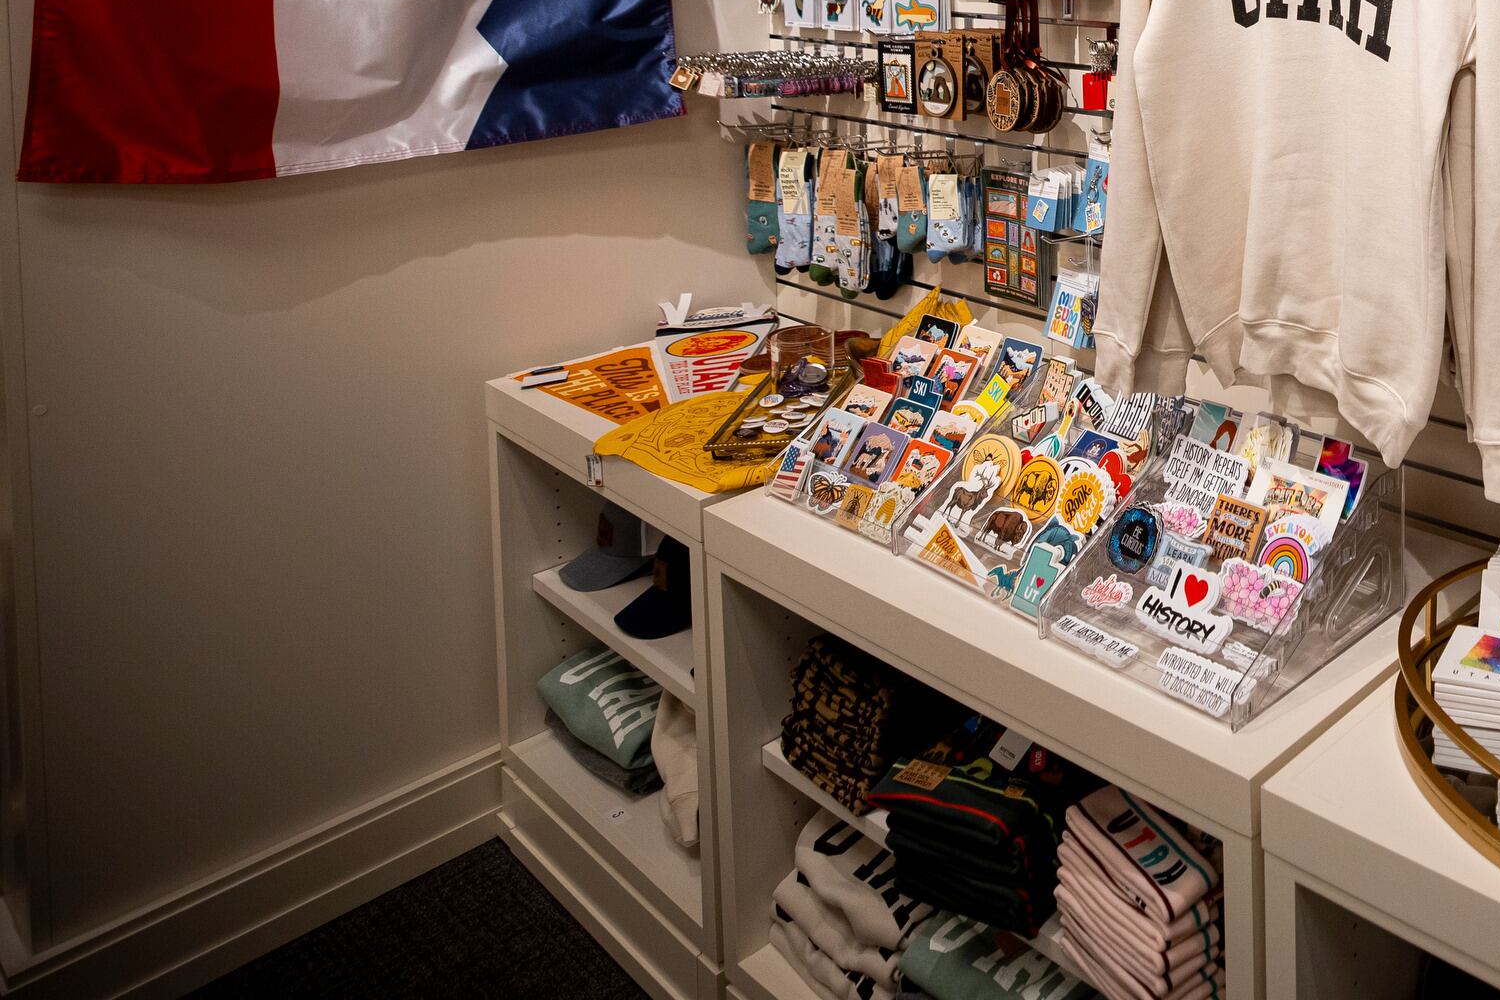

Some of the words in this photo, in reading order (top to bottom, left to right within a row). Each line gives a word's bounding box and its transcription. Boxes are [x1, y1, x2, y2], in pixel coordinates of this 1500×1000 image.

[991, 173, 1018, 183] EXPLORE
[1058, 291, 1082, 312] MUS
[1051, 319, 1075, 339] NERD
[543, 368, 608, 396] THE
[594, 357, 655, 390] This
[625, 384, 661, 402] IS
[691, 352, 749, 393] UTAH
[913, 380, 928, 397] SKI
[988, 381, 1004, 403] SKI
[570, 389, 641, 419] PLACE
[1173, 438, 1183, 456] IF
[1182, 441, 1213, 468] HISTORY
[1211, 453, 1243, 481] REPEATS
[1166, 457, 1191, 480] ITSELF
[1189, 466, 1205, 486] I'M
[1203, 473, 1237, 496] GETTING
[1168, 480, 1178, 497] A
[1176, 482, 1216, 514] DINOSAUR
[1219, 499, 1261, 522] THERE'S
[1121, 533, 1145, 556] CURIOUS
[1133, 525, 1143, 540] BE
[1211, 518, 1255, 544] MORE
[1266, 522, 1317, 552] EVERYONE
[1166, 547, 1195, 565] LEARN
[1205, 537, 1247, 561] DISCOVER
[1023, 586, 1040, 603] UT
[1170, 567, 1183, 600] I
[1141, 593, 1216, 645] HISTORY
[1160, 650, 1202, 680] INTROVERTED
[1200, 668, 1216, 685] BUT
[1161, 671, 1173, 688] TO
[1169, 675, 1199, 700] DISCUSS
[1195, 687, 1225, 713] HISTORY
[1106, 808, 1188, 887] UTAH
